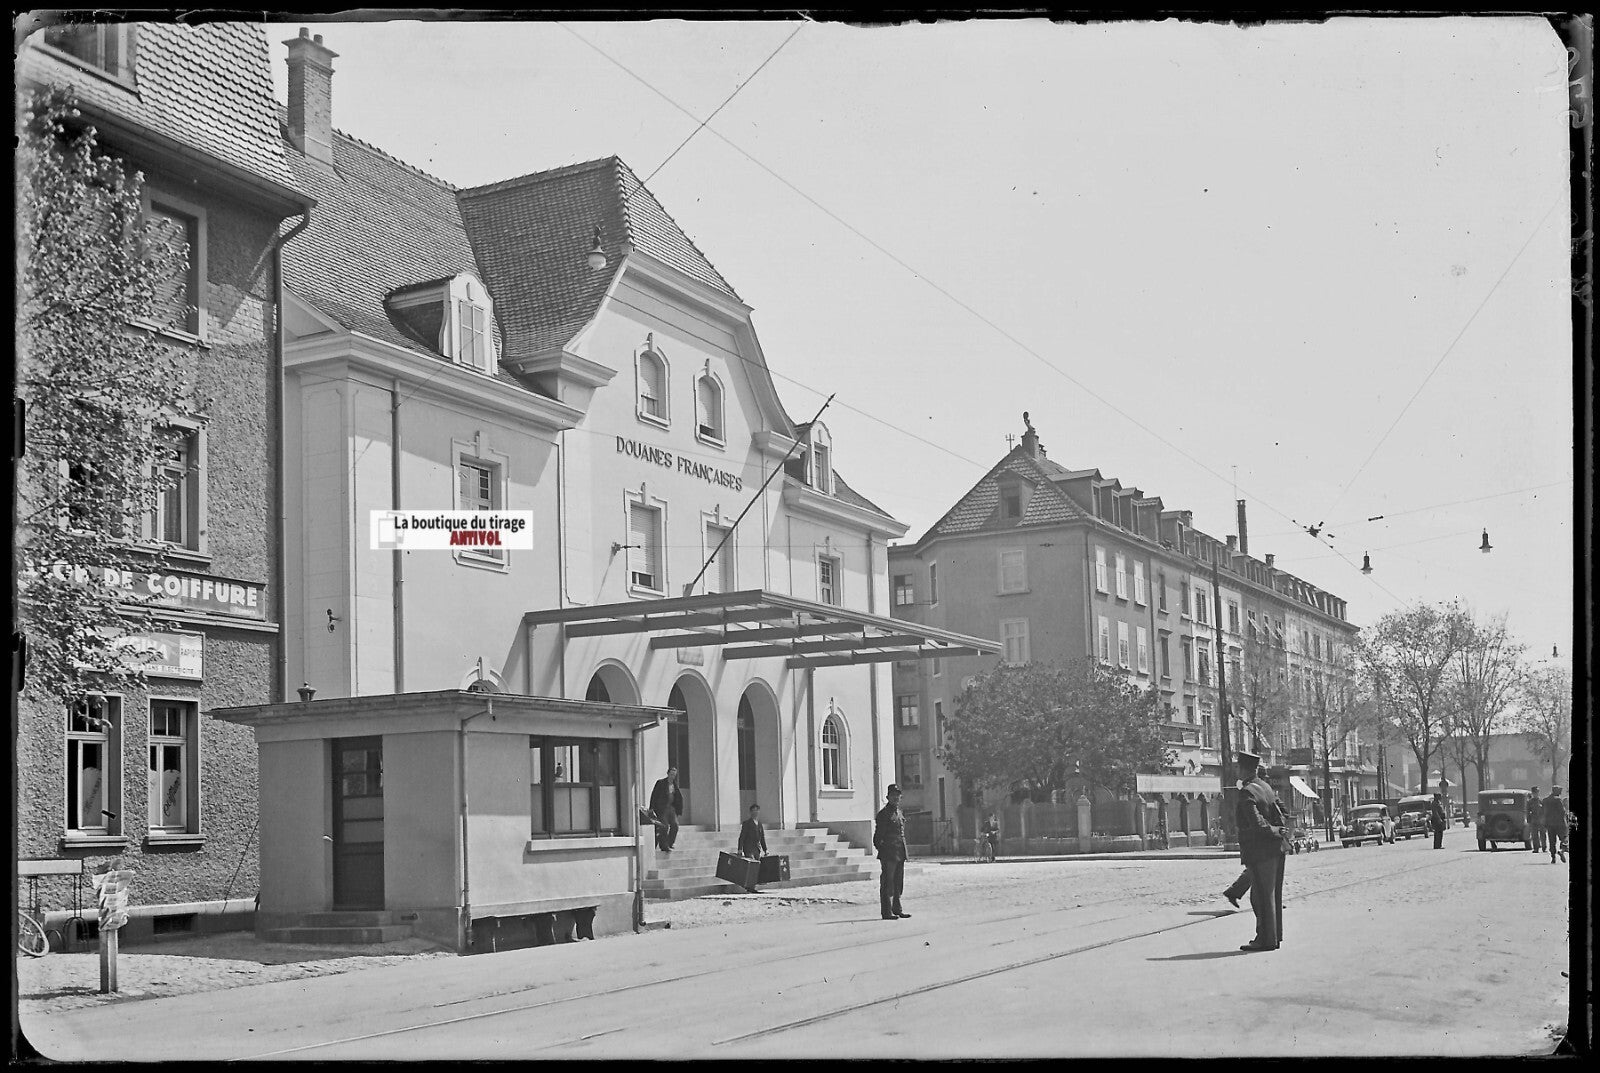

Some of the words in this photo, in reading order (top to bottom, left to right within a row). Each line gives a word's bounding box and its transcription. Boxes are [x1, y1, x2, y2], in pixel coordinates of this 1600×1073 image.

[616, 435, 673, 468] DOUANES
[677, 456, 743, 492] FRANÇAISES
[104, 568, 133, 590] DE
[147, 572, 257, 607] COIFFURE
